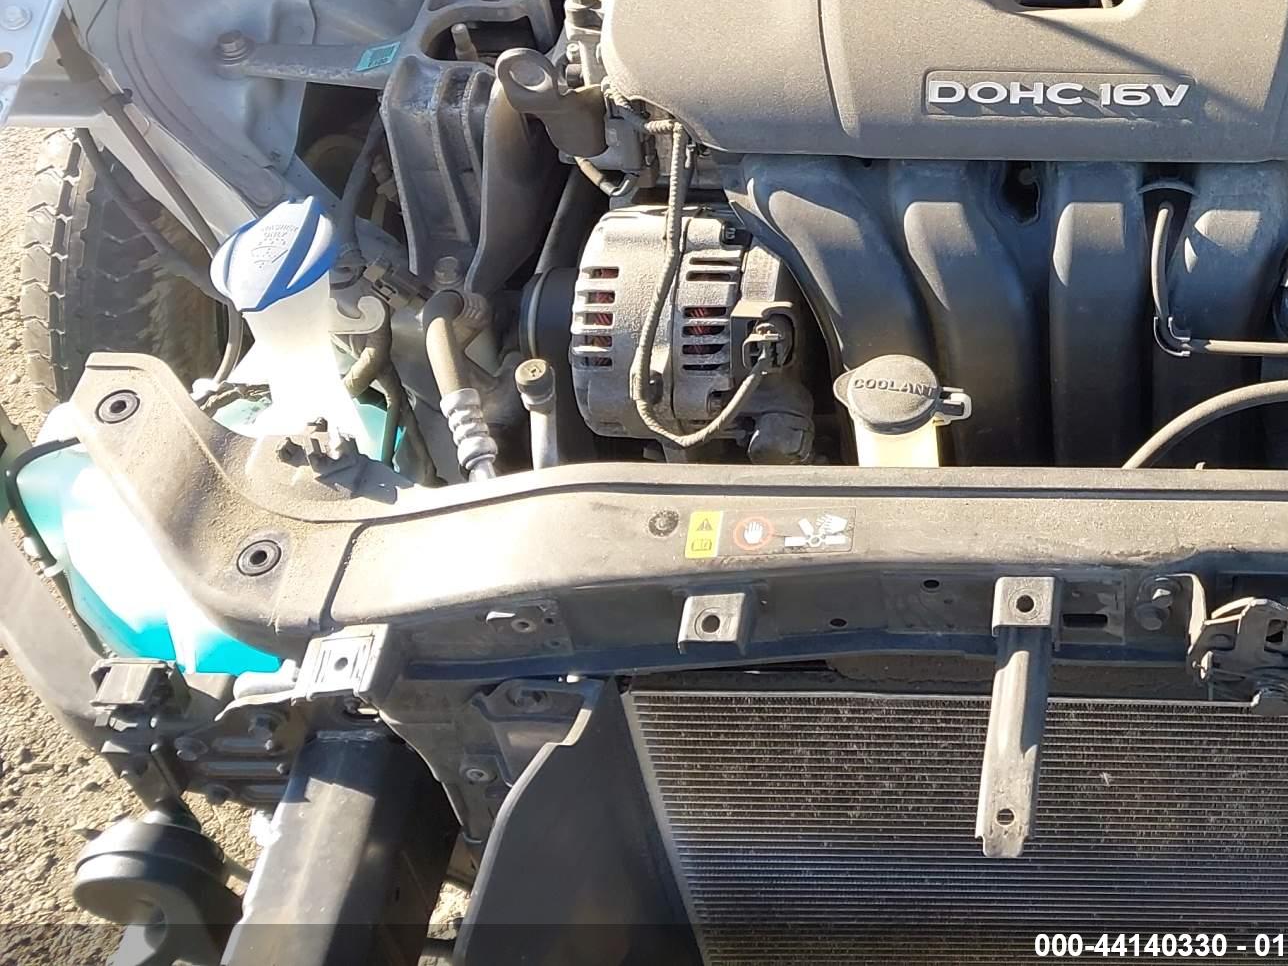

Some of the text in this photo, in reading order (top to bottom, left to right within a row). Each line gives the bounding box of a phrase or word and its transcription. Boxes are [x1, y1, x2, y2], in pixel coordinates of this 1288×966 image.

[929, 80, 1189, 107] DOHC 16V
[853, 378, 934, 398] COOLANT
